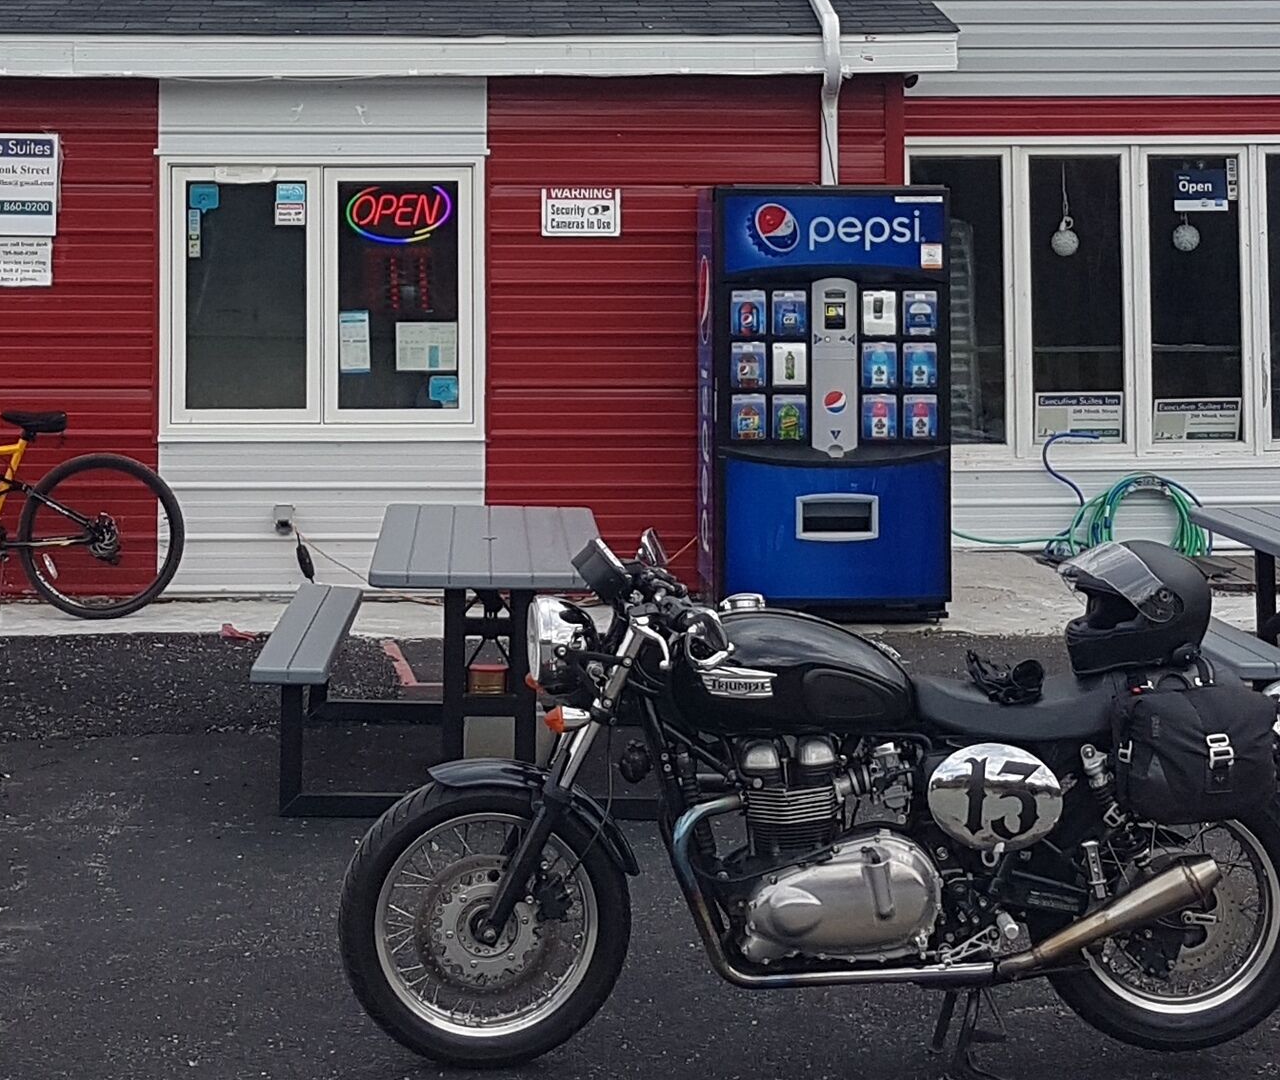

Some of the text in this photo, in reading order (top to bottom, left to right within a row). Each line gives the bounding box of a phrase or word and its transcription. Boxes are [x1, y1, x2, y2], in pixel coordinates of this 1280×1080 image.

[8, 140, 51, 155] Suites
[19, 165, 51, 175] Street
[550, 188, 613, 199] WARNING
[1178, 180, 1212, 194] Open
[3, 202, 50, 212] 860-0200
[352, 193, 441, 226] OPEN
[551, 204, 585, 217] Security
[551, 218, 612, 230] Cameras In Use
[808, 209, 921, 251] pepsi
[1039, 396, 1119, 405] Executive Suites Inn
[1159, 403, 1196, 411] Executive
[1197, 402, 1221, 410] Suites
[711, 679, 766, 692] TRIUMPH
[964, 756, 1042, 840] 13
